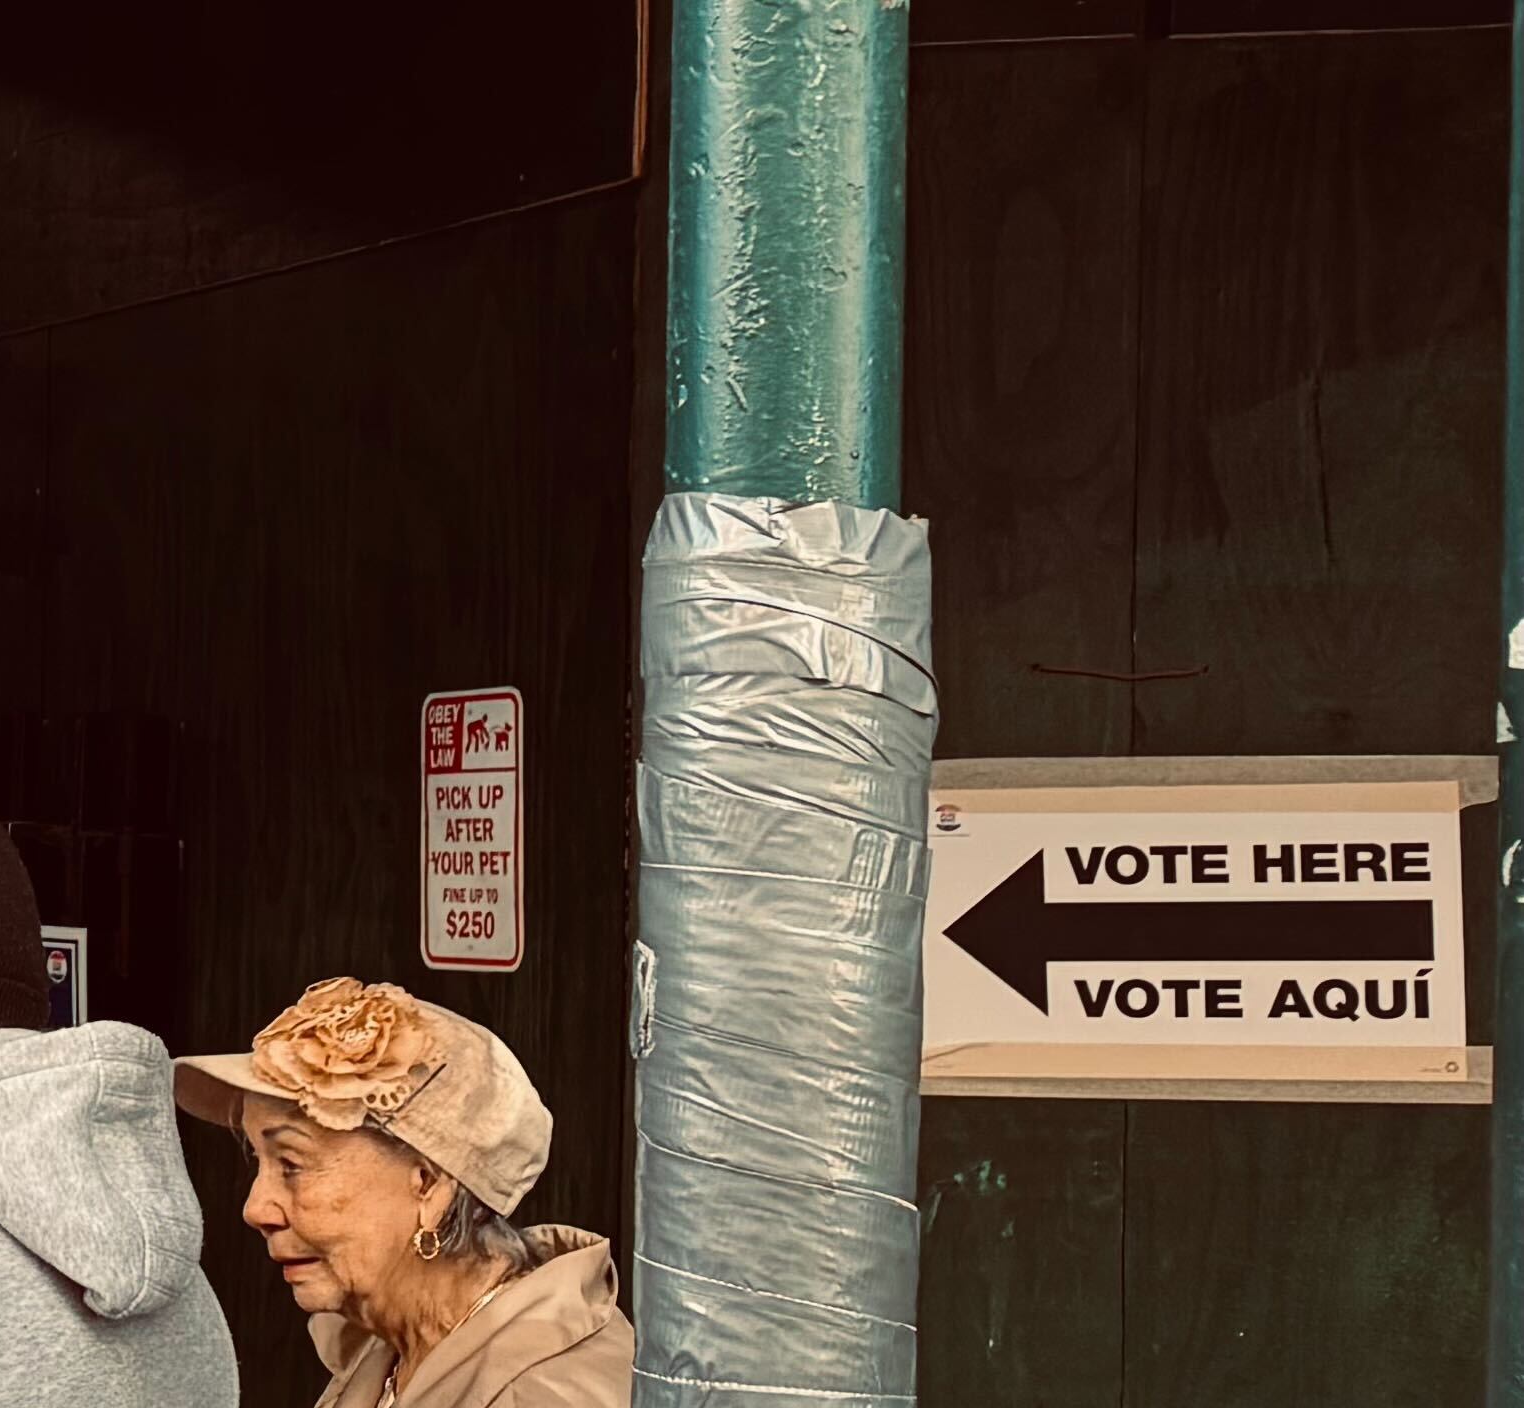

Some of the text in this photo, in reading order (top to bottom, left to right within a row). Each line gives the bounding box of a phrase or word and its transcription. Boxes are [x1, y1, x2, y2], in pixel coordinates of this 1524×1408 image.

[428, 703, 461, 725] OBEY
[431, 726, 454, 746] THE
[430, 748, 455, 768] LAW
[436, 785, 504, 810] PICK UP
[445, 818, 494, 843] AFTER
[430, 851, 510, 876] YOUR PET
[1065, 842, 1431, 885] VOTE HERE
[443, 887, 498, 904] FINE UP TO
[446, 910, 495, 940] $250
[1074, 968, 1433, 1022] VOTE AQUÍ
